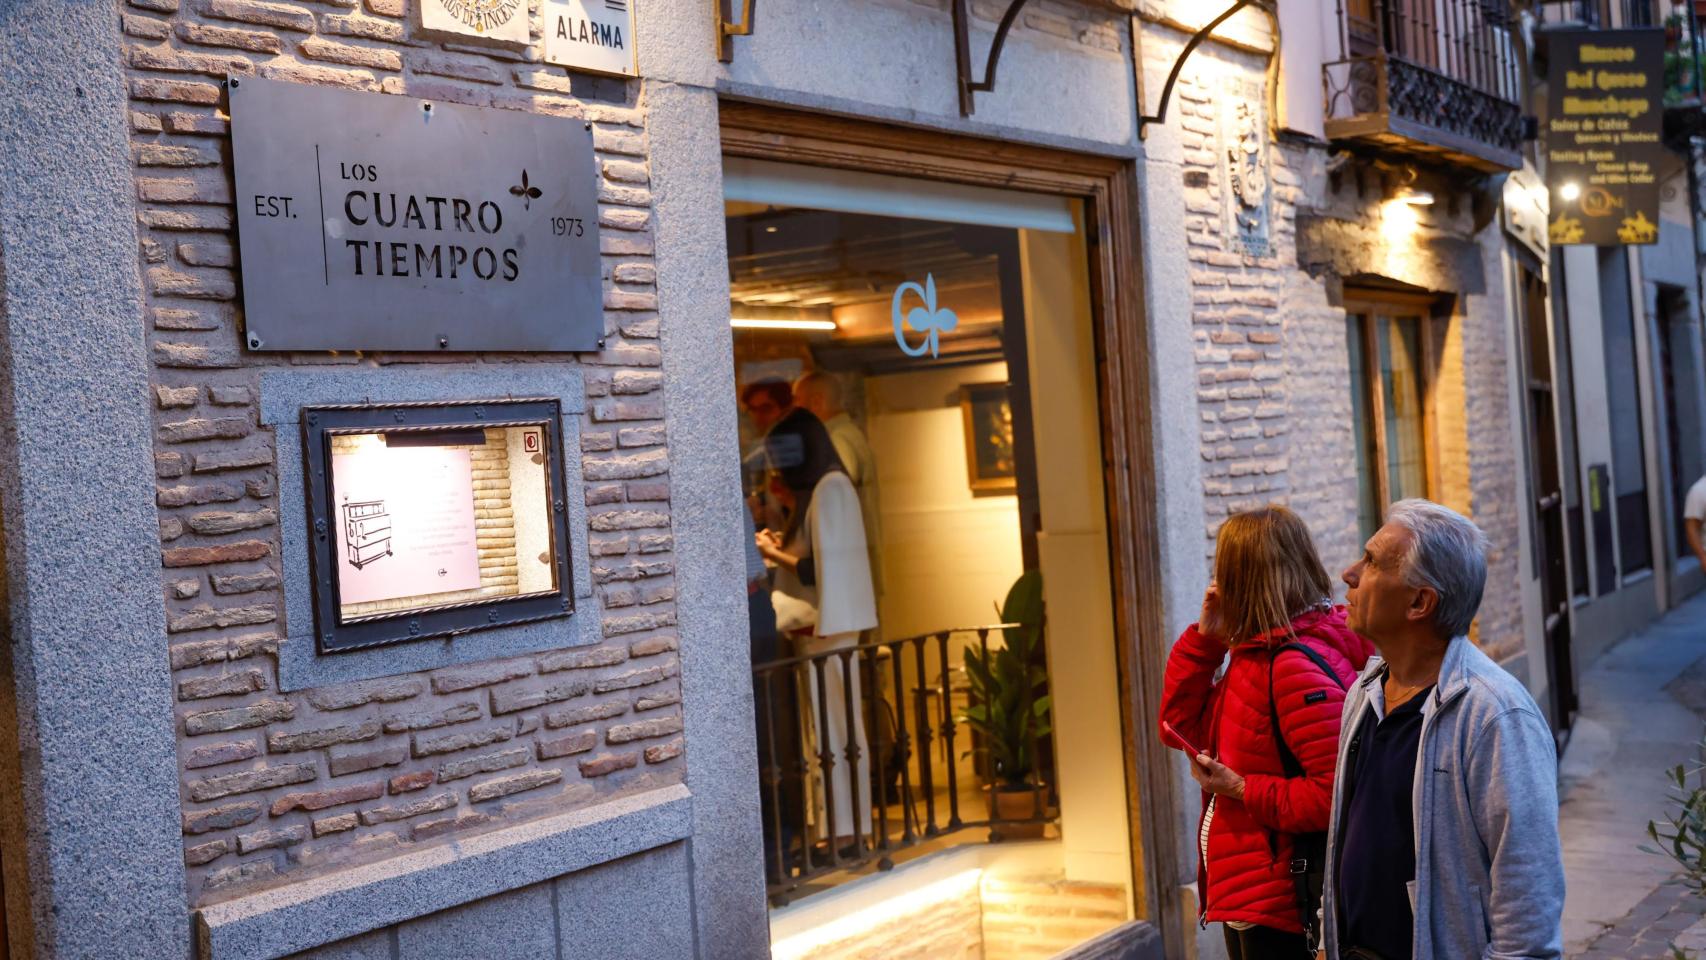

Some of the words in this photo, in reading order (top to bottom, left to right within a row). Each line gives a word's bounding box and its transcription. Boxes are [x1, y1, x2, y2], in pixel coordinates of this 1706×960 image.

[557, 15, 624, 50] ALARMA
[341, 162, 378, 182] LOS
[254, 195, 297, 219] EST.
[344, 190, 503, 235] CUATRO
[550, 216, 585, 238] 1973
[345, 240, 520, 282] TIEMPOS
